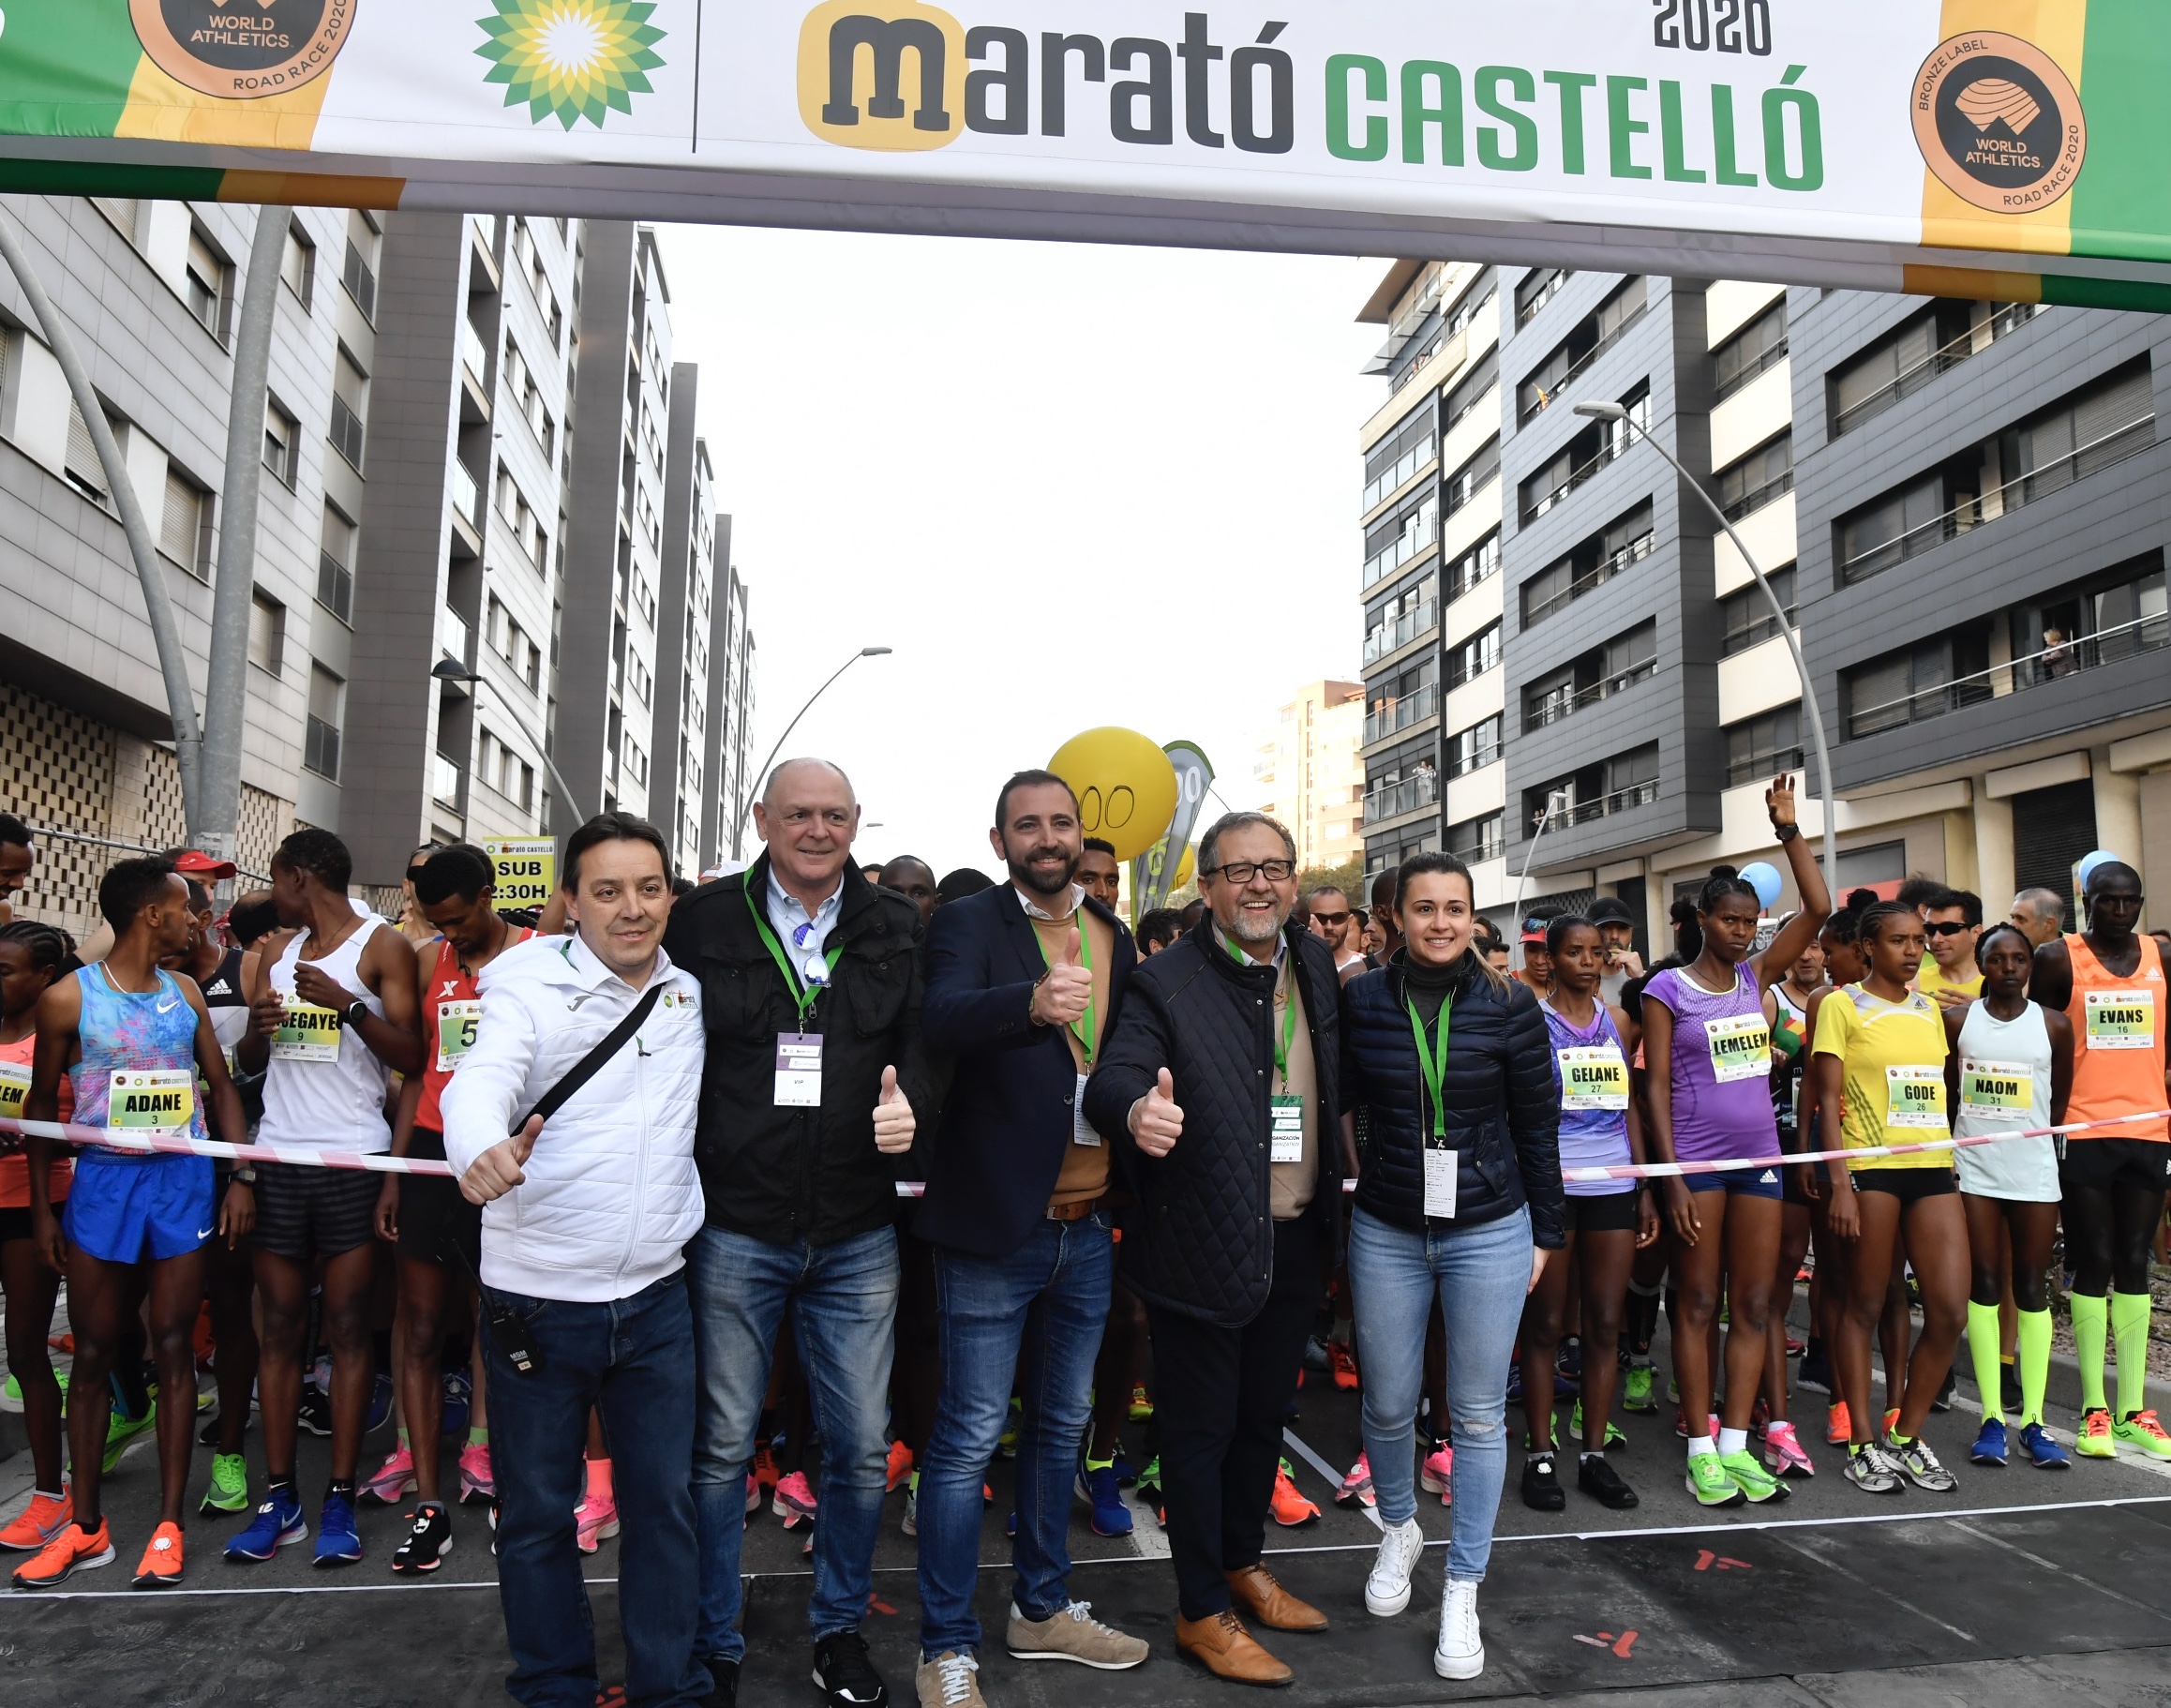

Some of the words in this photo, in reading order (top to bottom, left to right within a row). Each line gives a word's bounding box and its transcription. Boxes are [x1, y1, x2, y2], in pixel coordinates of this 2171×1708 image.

[209, 15, 275, 31] WORLD
[1653, 0, 1772, 57] 2020
[190, 29, 290, 48] ATHLETICS
[233, 73, 285, 90] ROAD
[288, 41, 329, 79] RACE
[1919, 56, 1948, 111] BRONZE
[1946, 39, 1988, 62] LABEL
[822, 12, 1294, 154] marató
[1325, 53, 1824, 191] CASTELLÓ
[1976, 139, 2027, 154] WORLD
[1966, 152, 2041, 169] ATHLETICS
[2003, 190, 2042, 205] ROAD
[2042, 163, 2072, 195] RACE
[2066, 125, 2079, 163] 2020
[498, 861, 542, 876] SUB
[2100, 1010, 2143, 1023] EVANS
[298, 1032, 304, 1041] 9
[1714, 1032, 1767, 1056] LEMELEM
[1571, 1067, 1620, 1083] GELANE
[1591, 1085, 1601, 1093] 27
[1904, 1085, 1936, 1101] GODE
[1975, 1079, 2017, 1096] NAOM
[125, 1094, 181, 1112] ADANE
[1917, 1102, 1926, 1111] 26
[152, 1116, 158, 1124] 3
